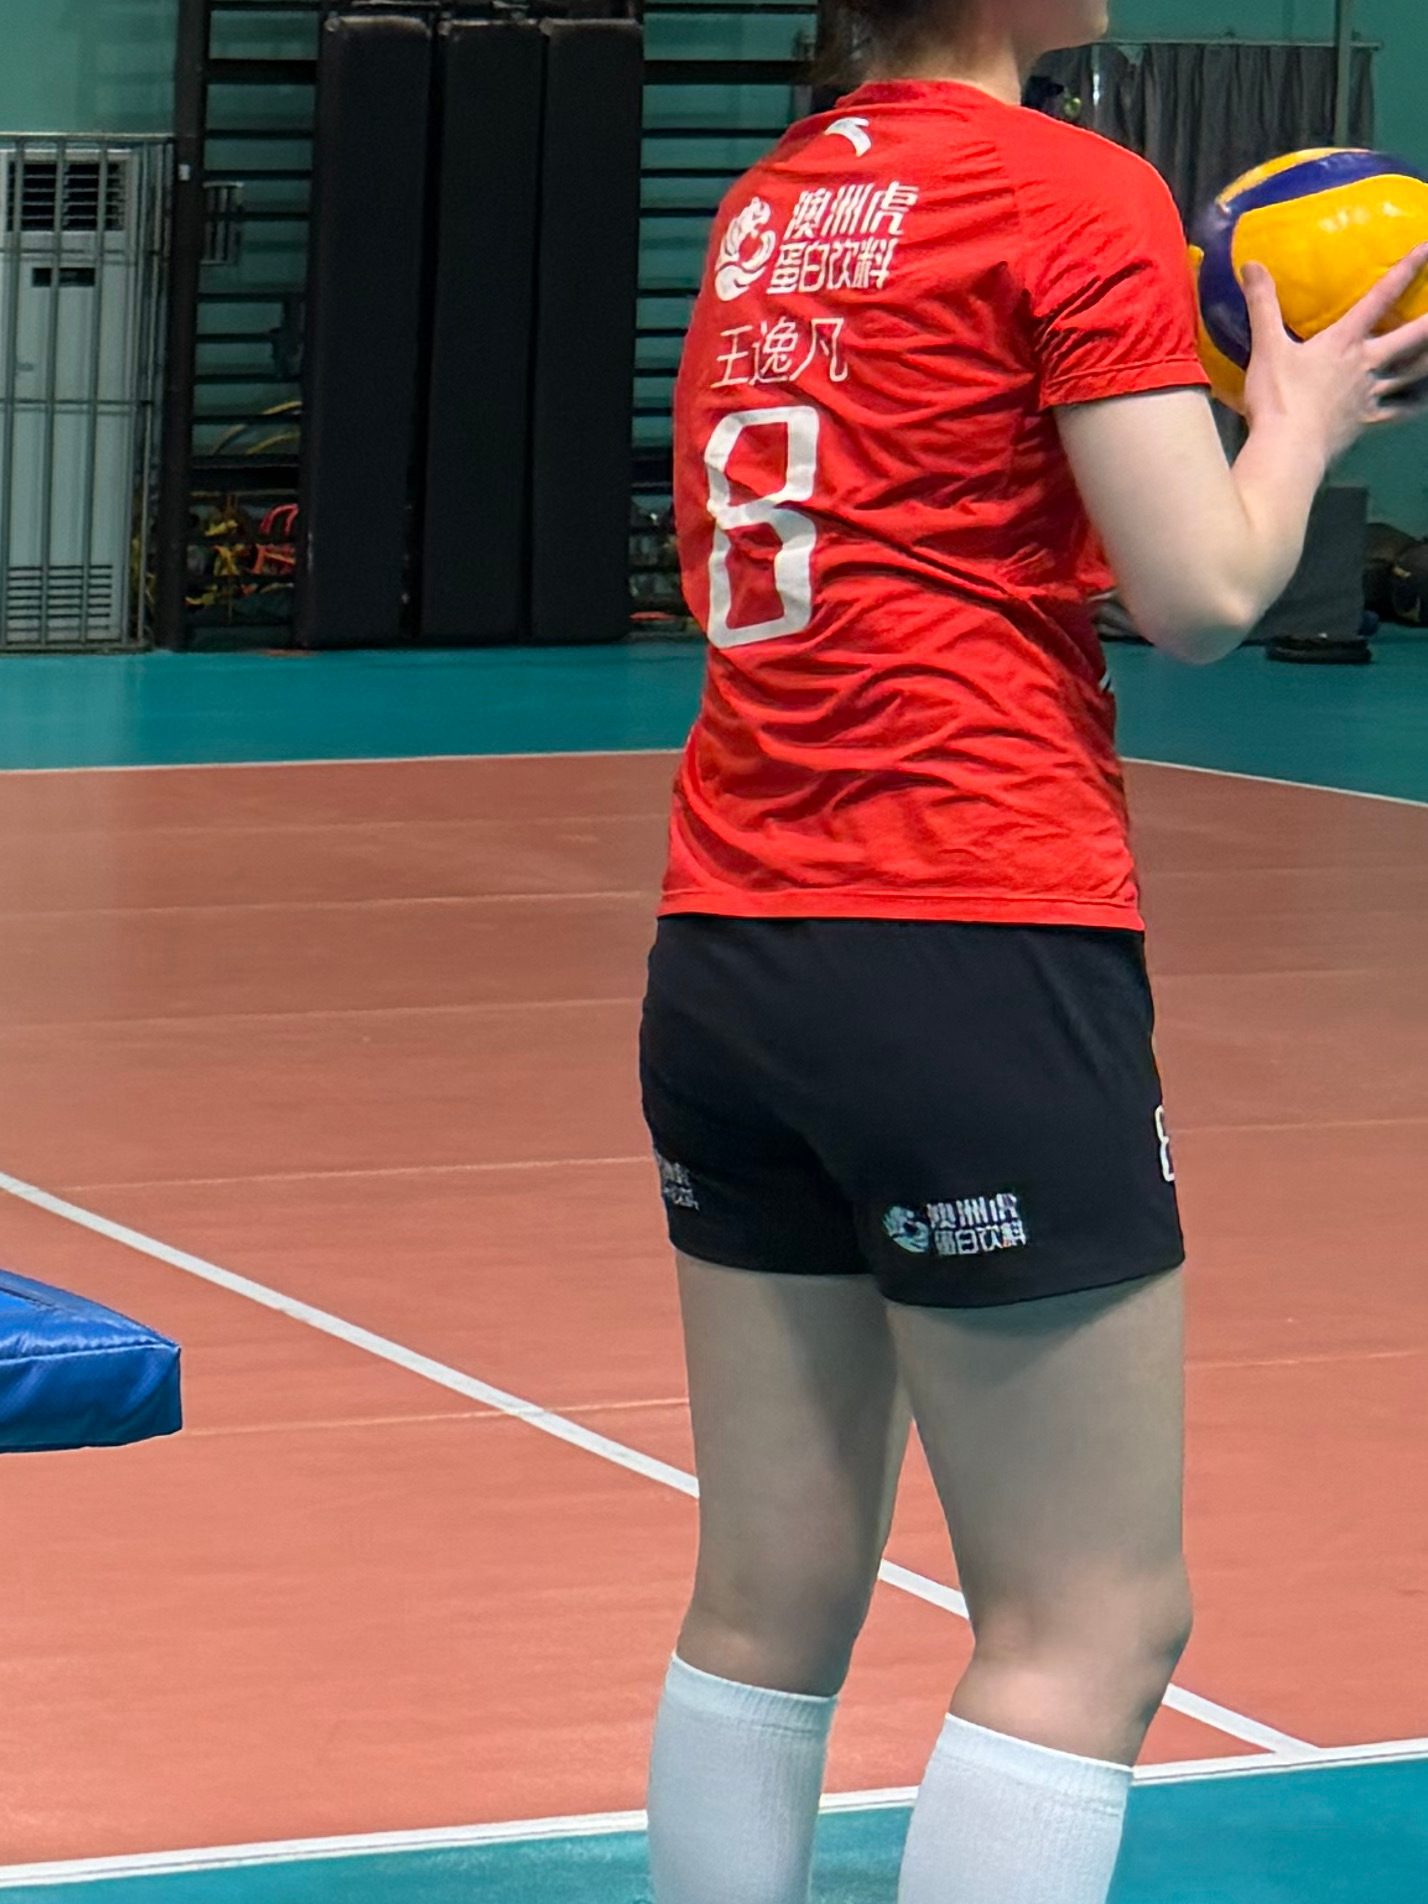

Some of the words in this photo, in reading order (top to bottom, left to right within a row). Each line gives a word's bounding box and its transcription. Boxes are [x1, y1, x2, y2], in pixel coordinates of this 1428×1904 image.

[784, 181, 919, 239] 澳洲虎
[766, 237, 899, 295] 蛋白饮料
[709, 314, 849, 388] 王逸凡
[705, 404, 820, 650] 8
